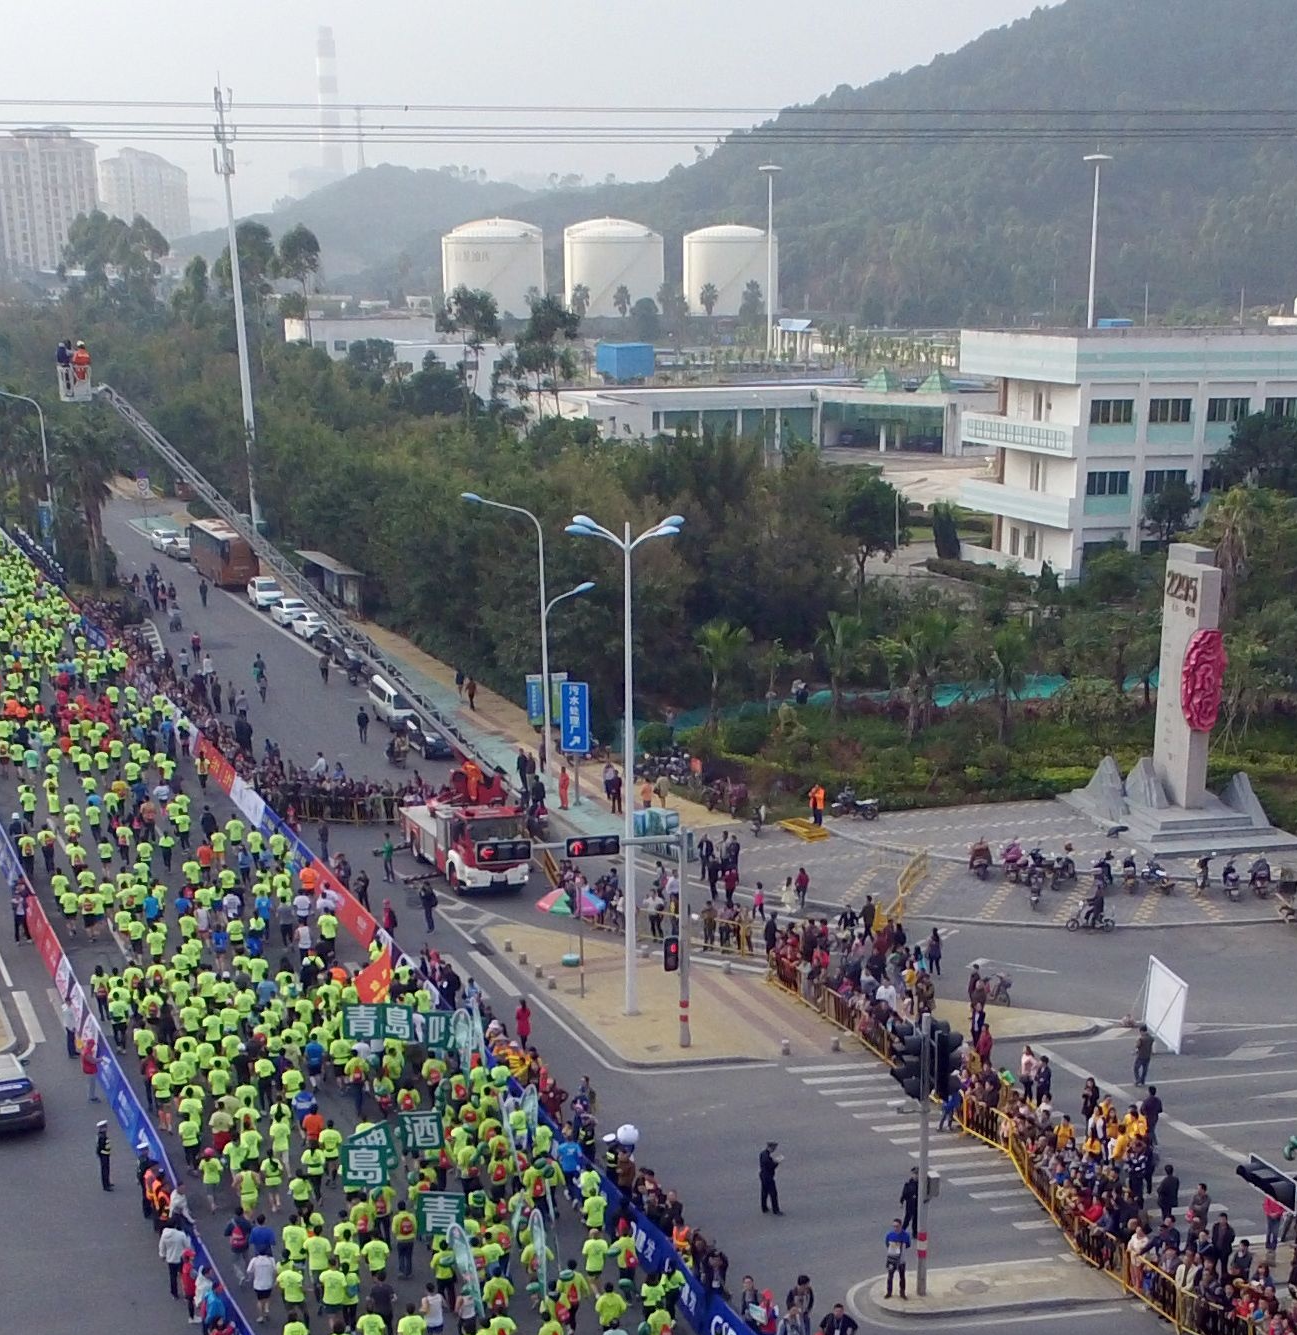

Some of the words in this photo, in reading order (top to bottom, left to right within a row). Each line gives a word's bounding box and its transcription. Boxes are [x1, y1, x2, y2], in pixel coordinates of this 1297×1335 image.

[1167, 570, 1199, 604] 2295
[406, 1116, 440, 1148] 酒
[422, 1198, 458, 1233] 青
